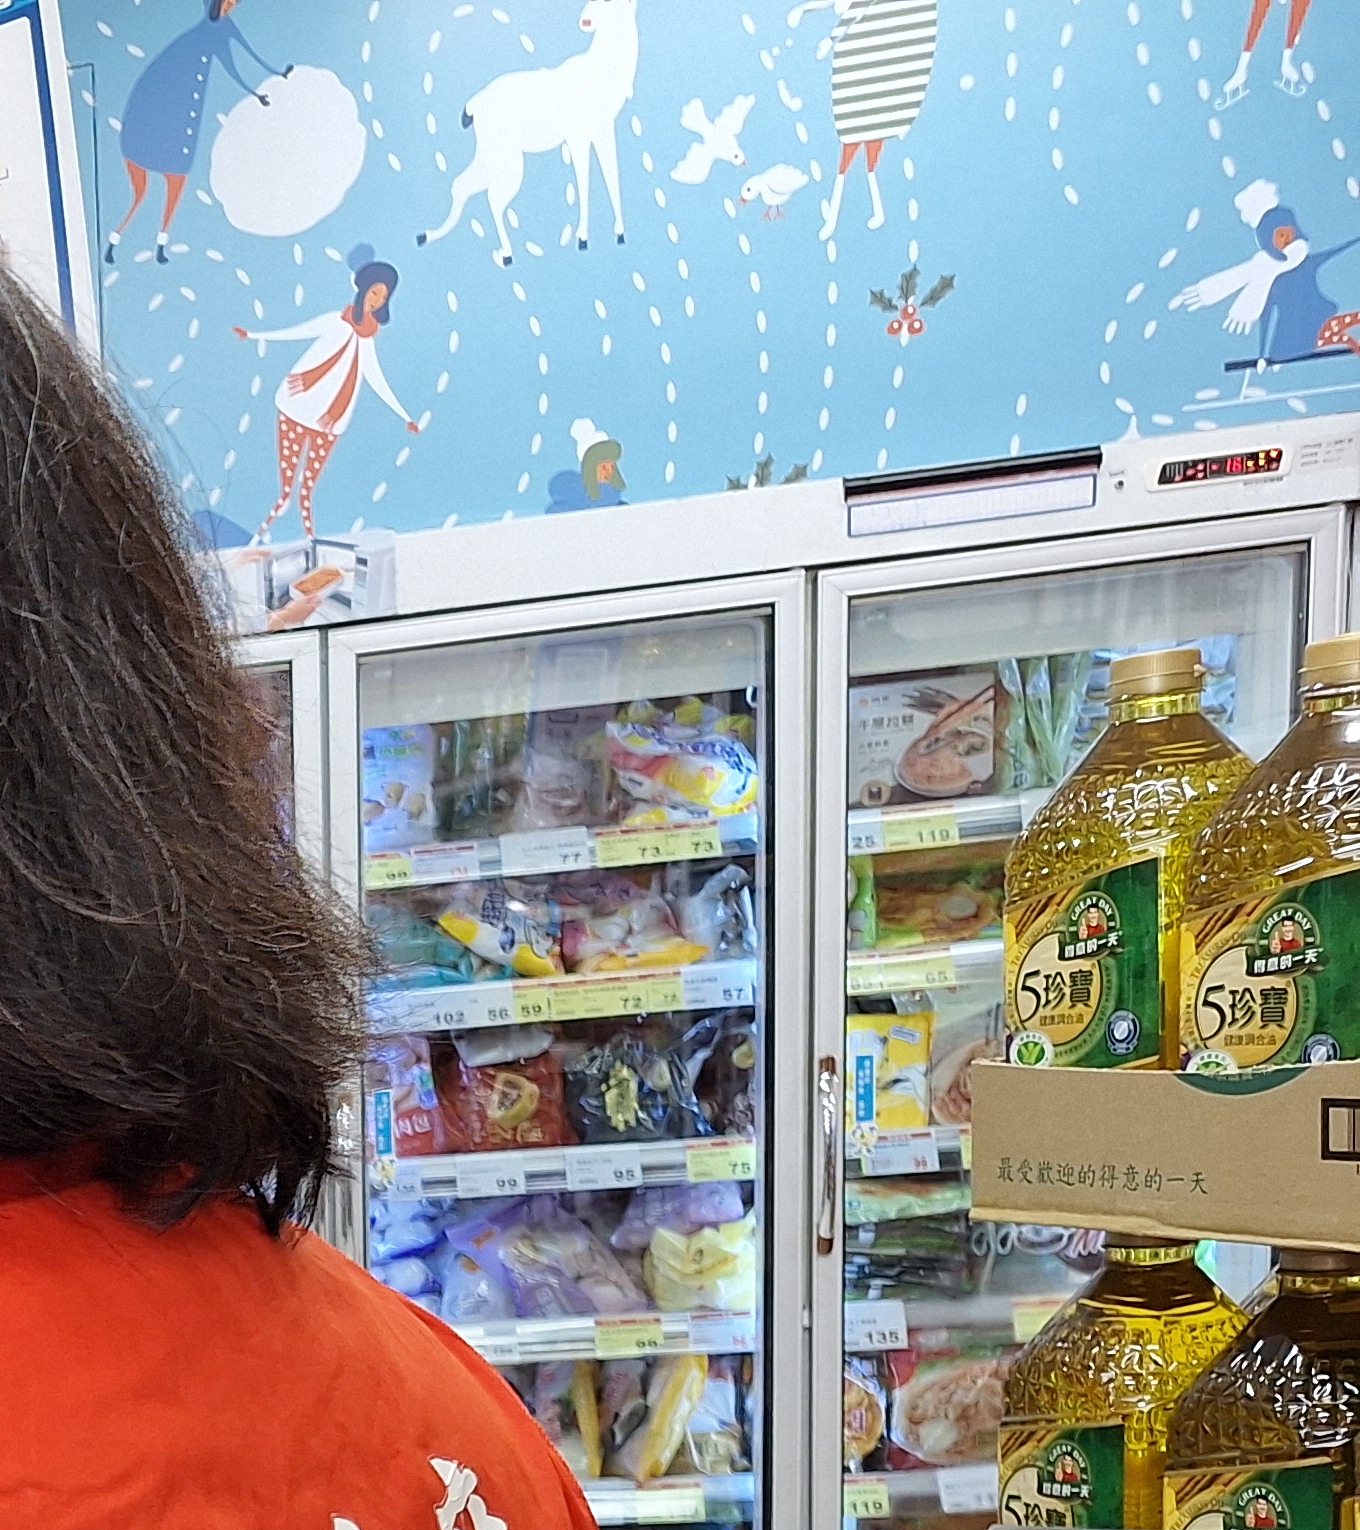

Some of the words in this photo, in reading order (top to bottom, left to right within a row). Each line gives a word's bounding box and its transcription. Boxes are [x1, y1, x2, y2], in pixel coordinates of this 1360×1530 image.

[1070, 896, 1098, 922] GREAT
[1098, 897, 1114, 918] DAY
[1262, 909, 1294, 935] GREAT
[1294, 912, 1312, 932] DAY
[1020, 968, 1095, 1023] 5珍寶
[1200, 982, 1290, 1042] 5珍寶
[996, 1156, 1209, 1196] 最受歡迎的得意的一天
[1238, 1487, 1267, 1506] GREAT
